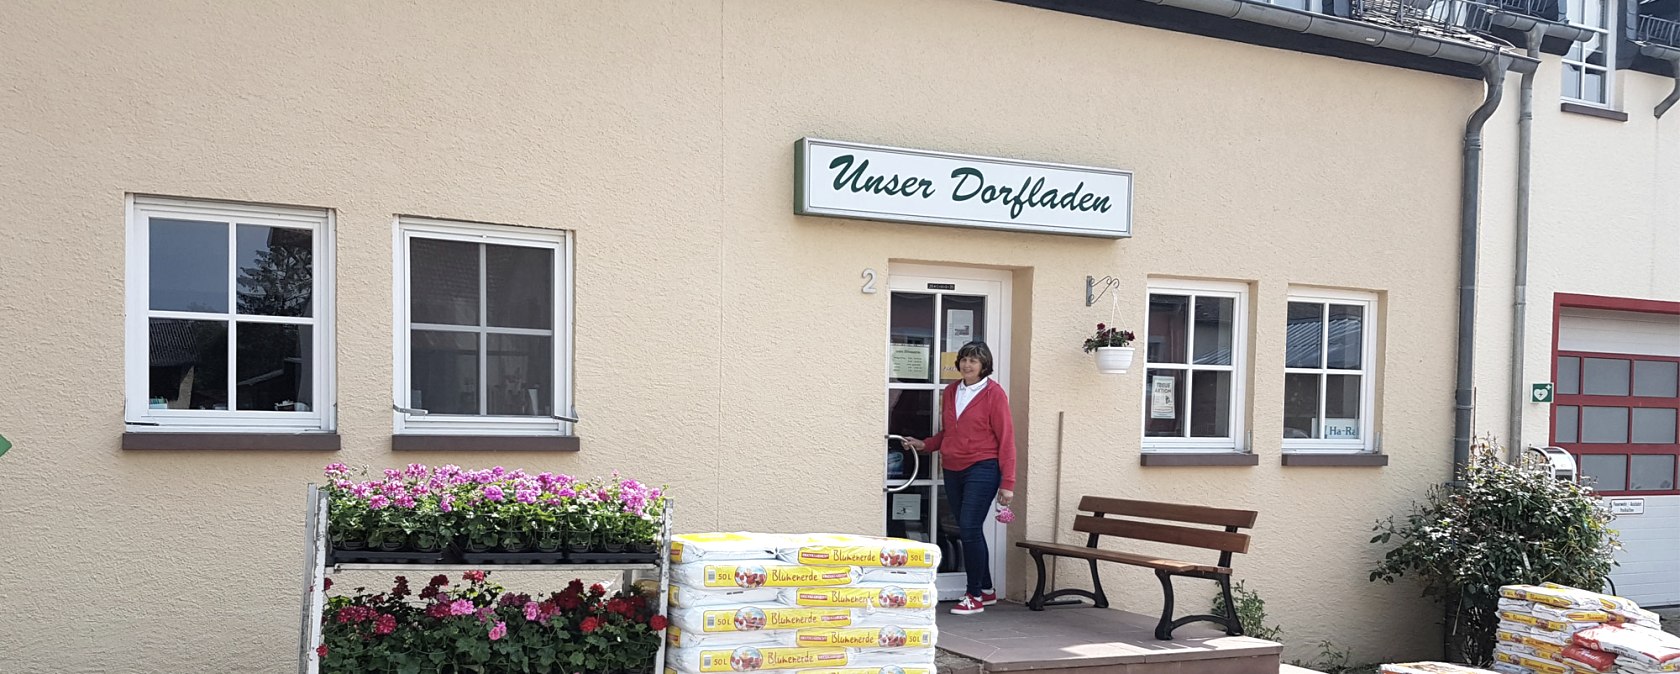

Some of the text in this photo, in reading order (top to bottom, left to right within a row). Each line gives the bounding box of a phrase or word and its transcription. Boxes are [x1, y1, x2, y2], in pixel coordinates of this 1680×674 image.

[828, 154, 1112, 219] Unser Dorfladen
[861, 268, 877, 294] 2
[833, 550, 876, 562] Blumenerde
[772, 569, 818, 582] Blumenerde
[771, 611, 817, 625] Blumenerde
[831, 631, 874, 644] Blumenerde
[767, 652, 814, 665] Blumenerde
